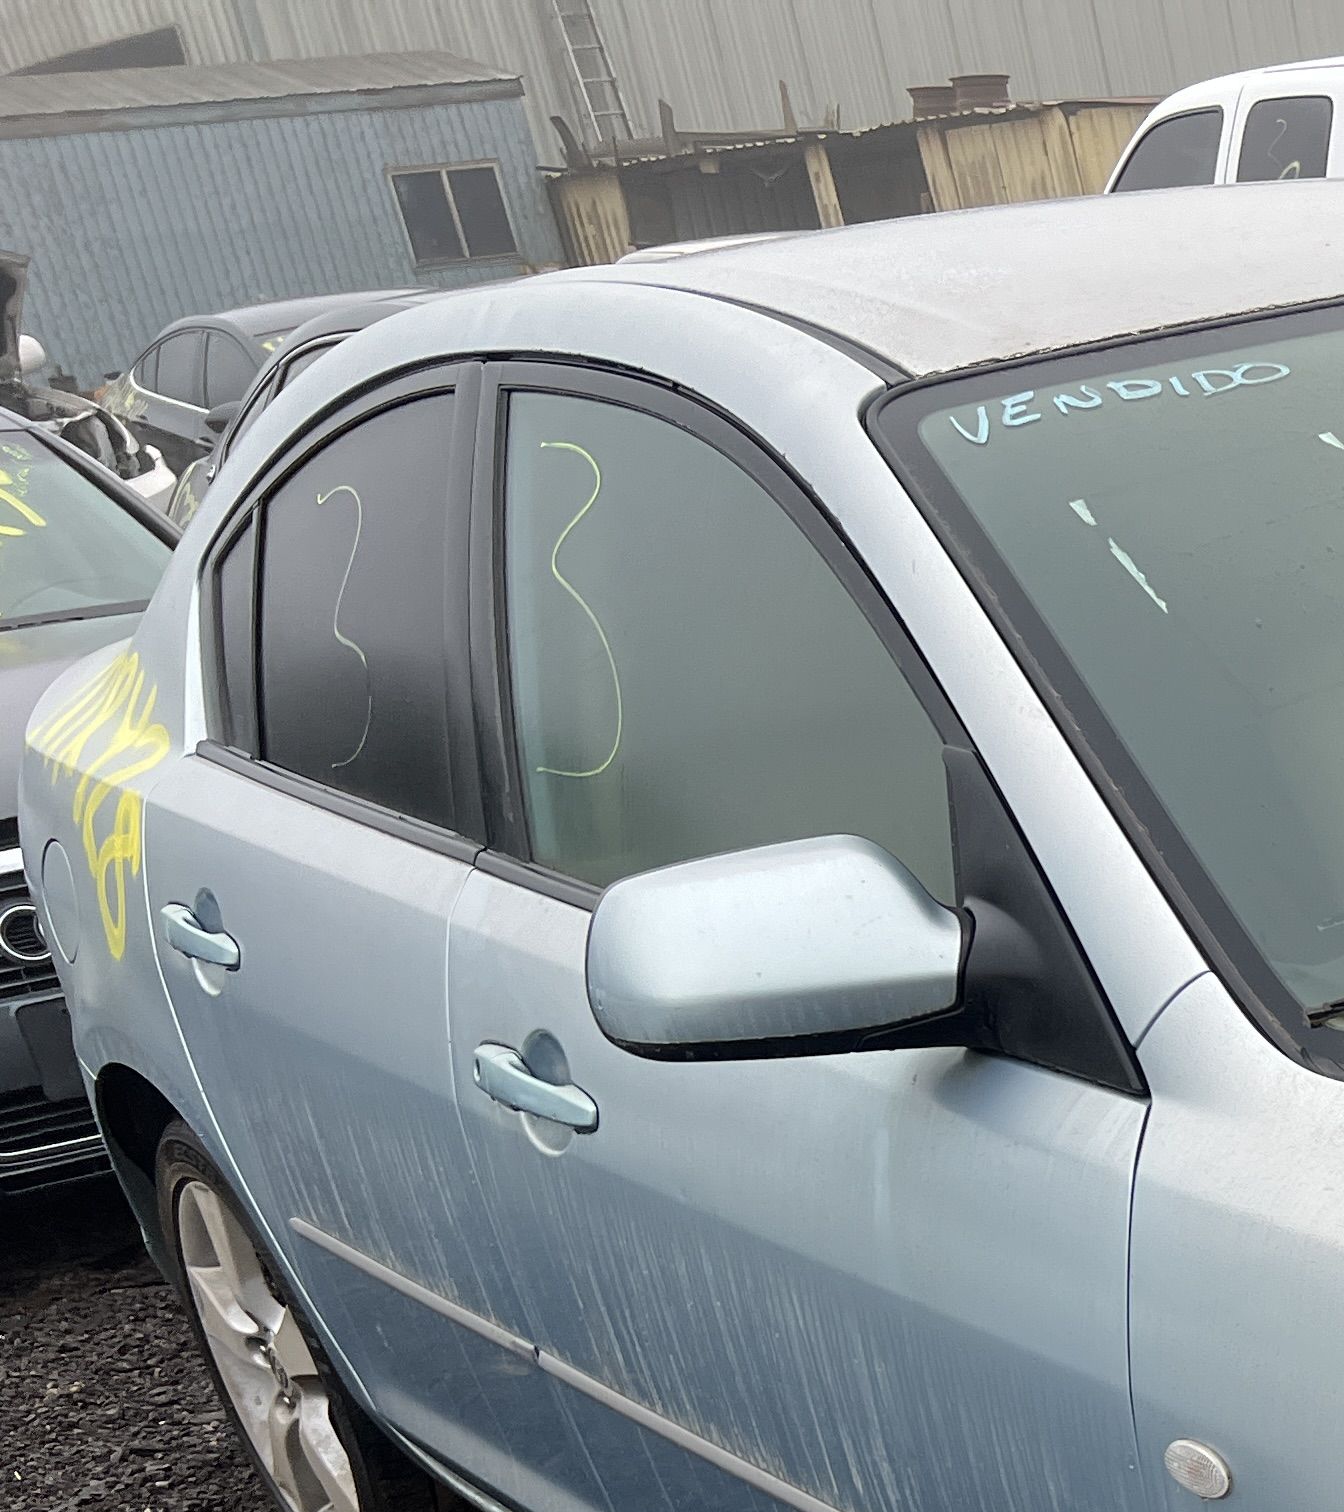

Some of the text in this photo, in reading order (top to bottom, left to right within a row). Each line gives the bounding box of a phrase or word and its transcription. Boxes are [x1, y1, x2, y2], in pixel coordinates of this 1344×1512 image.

[949, 361, 1291, 446] VENDIDO
[316, 485, 373, 768] 3
[536, 440, 624, 778] 3
